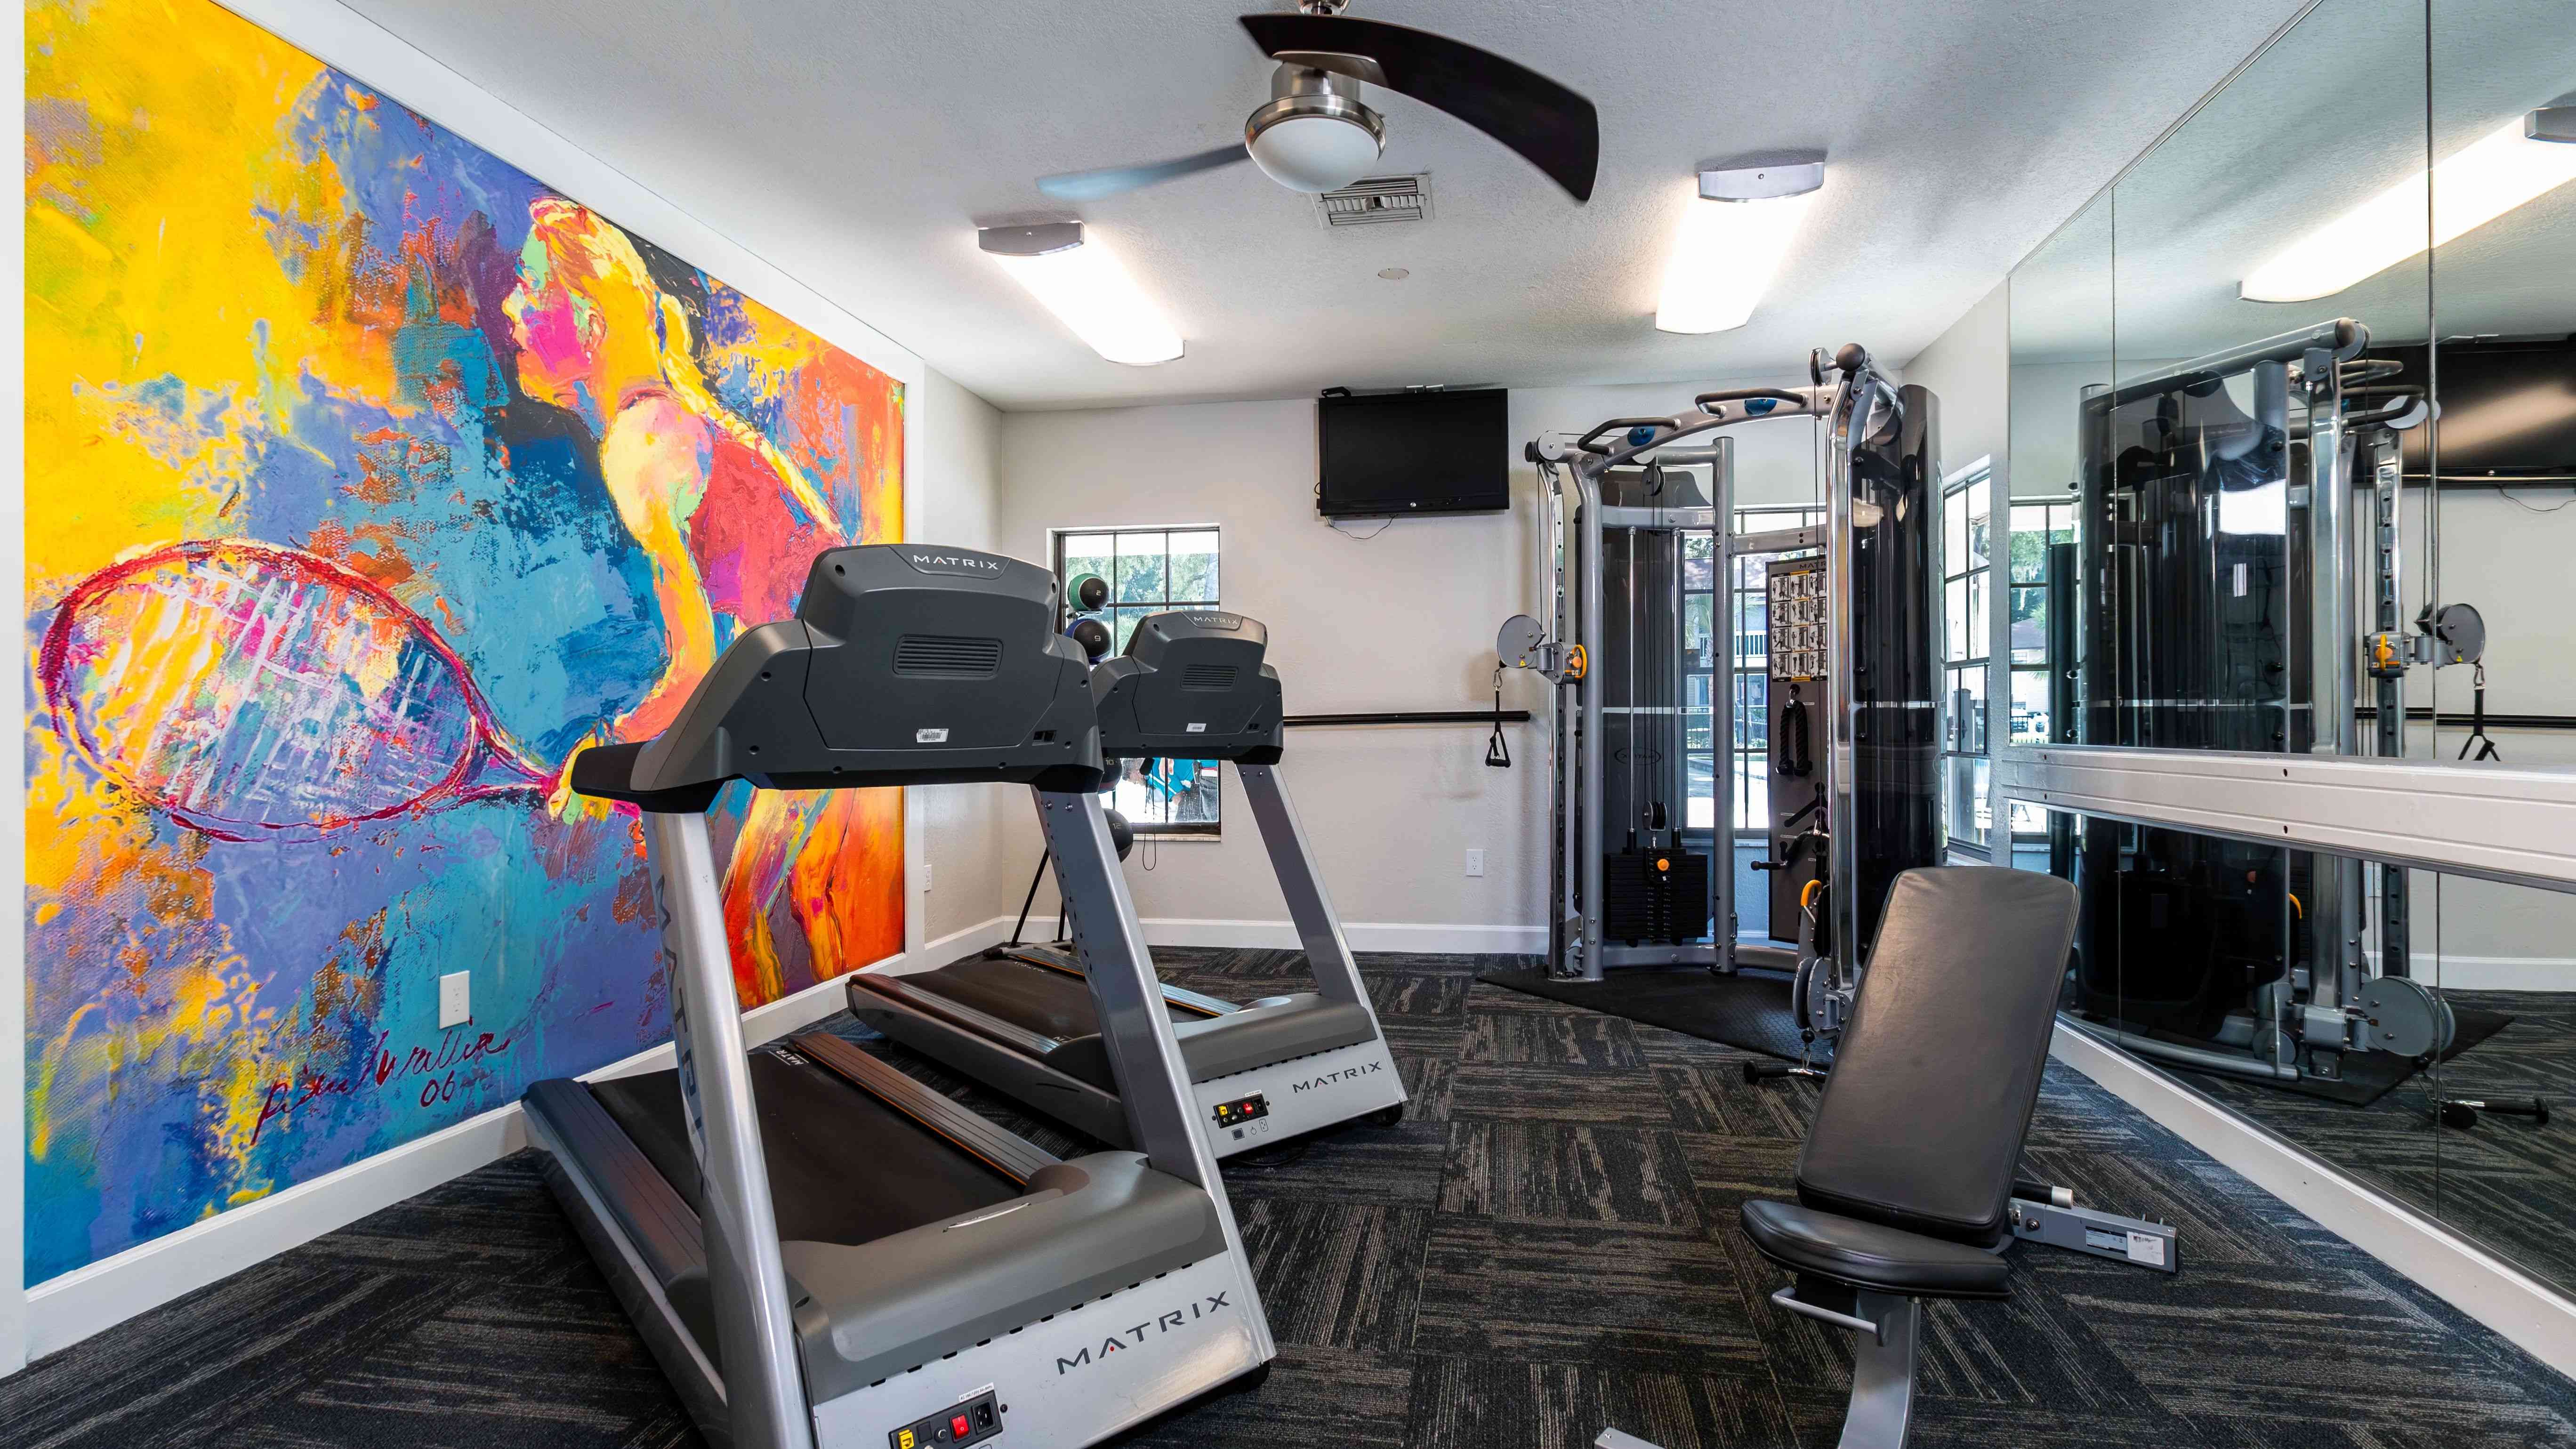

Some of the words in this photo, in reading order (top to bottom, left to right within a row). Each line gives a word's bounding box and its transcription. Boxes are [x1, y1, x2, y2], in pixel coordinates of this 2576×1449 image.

[913, 555, 998, 570] MATRIX
[1292, 1061, 1382, 1093] MATRIX
[1056, 1290, 1230, 1375] MATRIX
